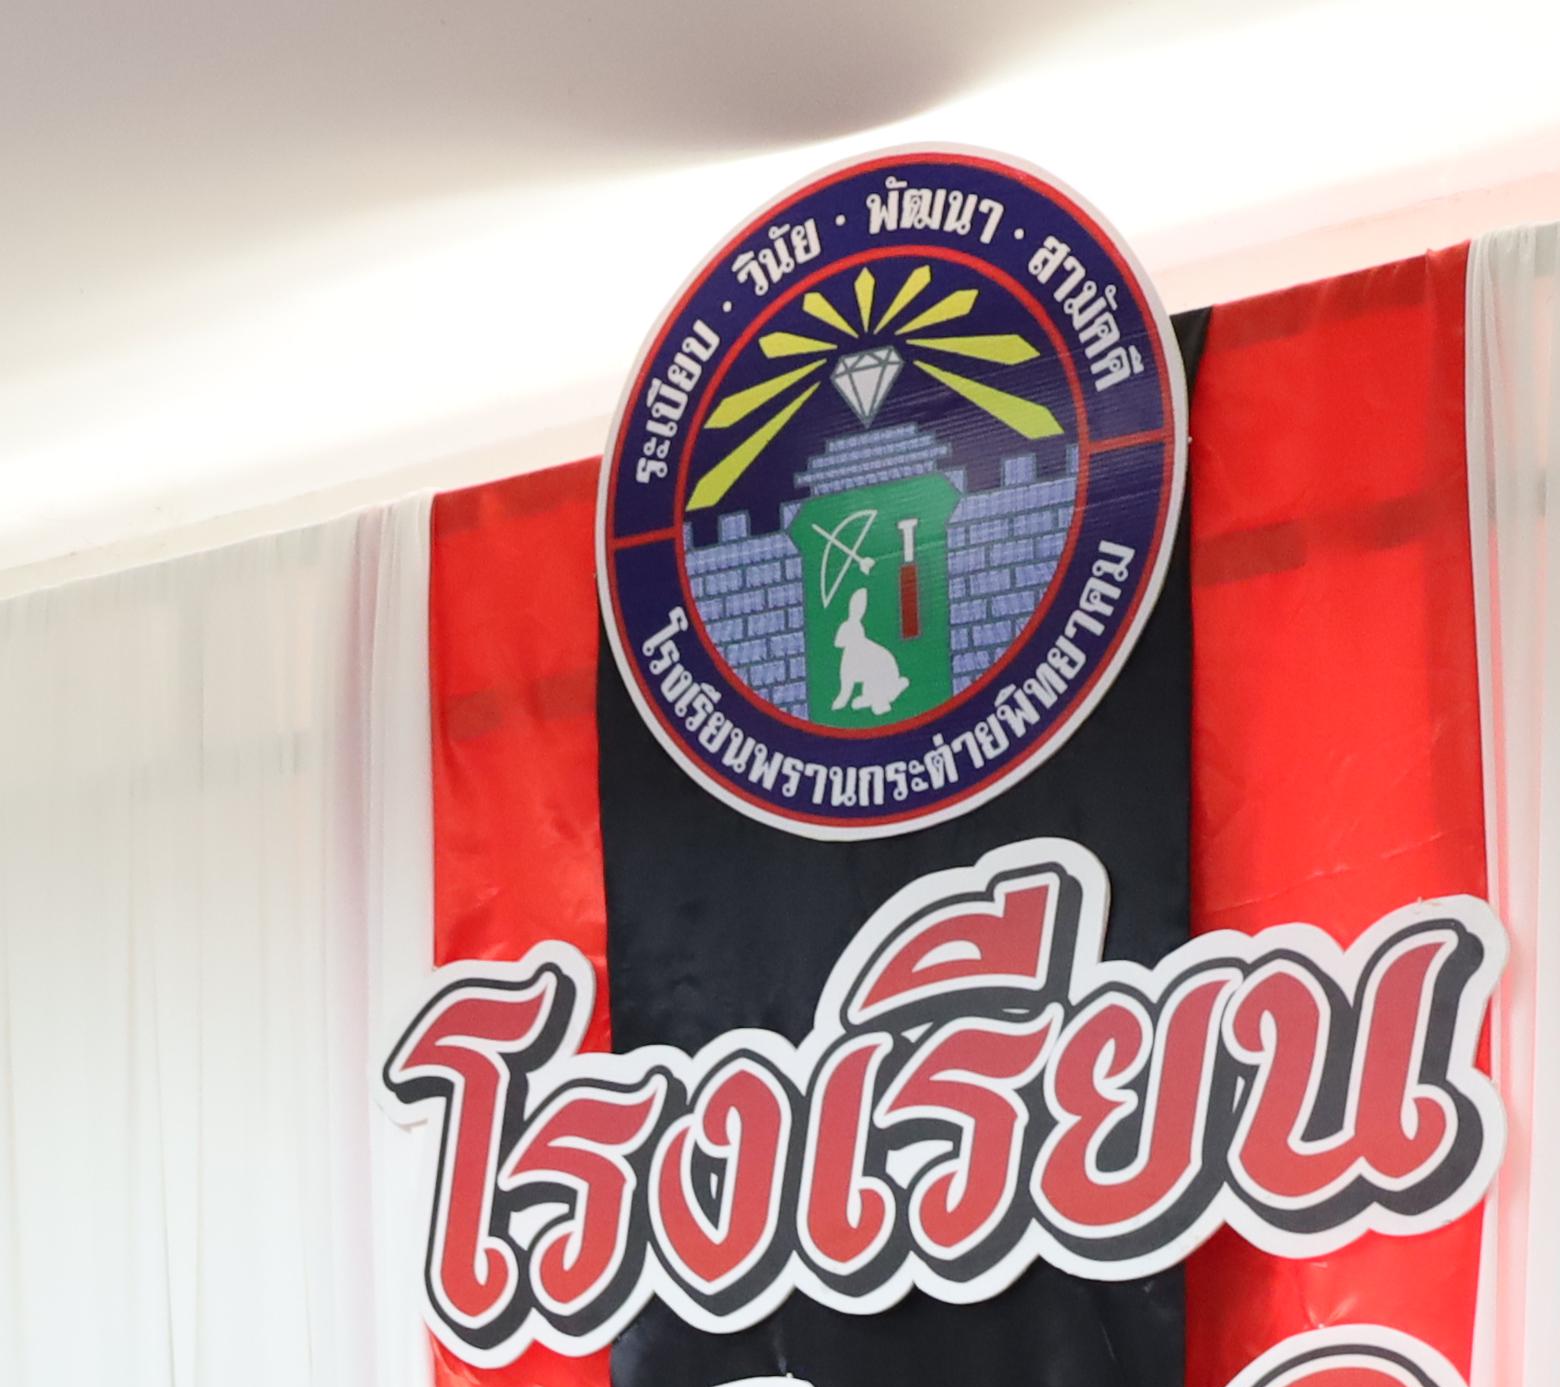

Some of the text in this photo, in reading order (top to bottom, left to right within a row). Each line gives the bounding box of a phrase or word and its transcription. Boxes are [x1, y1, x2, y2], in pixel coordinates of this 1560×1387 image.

[635, 176, 1145, 484] ระเบียบ วินัย พัฒนา สามัคคี
[641, 541, 1136, 807] โรงเรียนพรานกระต่ายพิทยาคม
[382, 858, 1486, 1354] โรงเรียน
